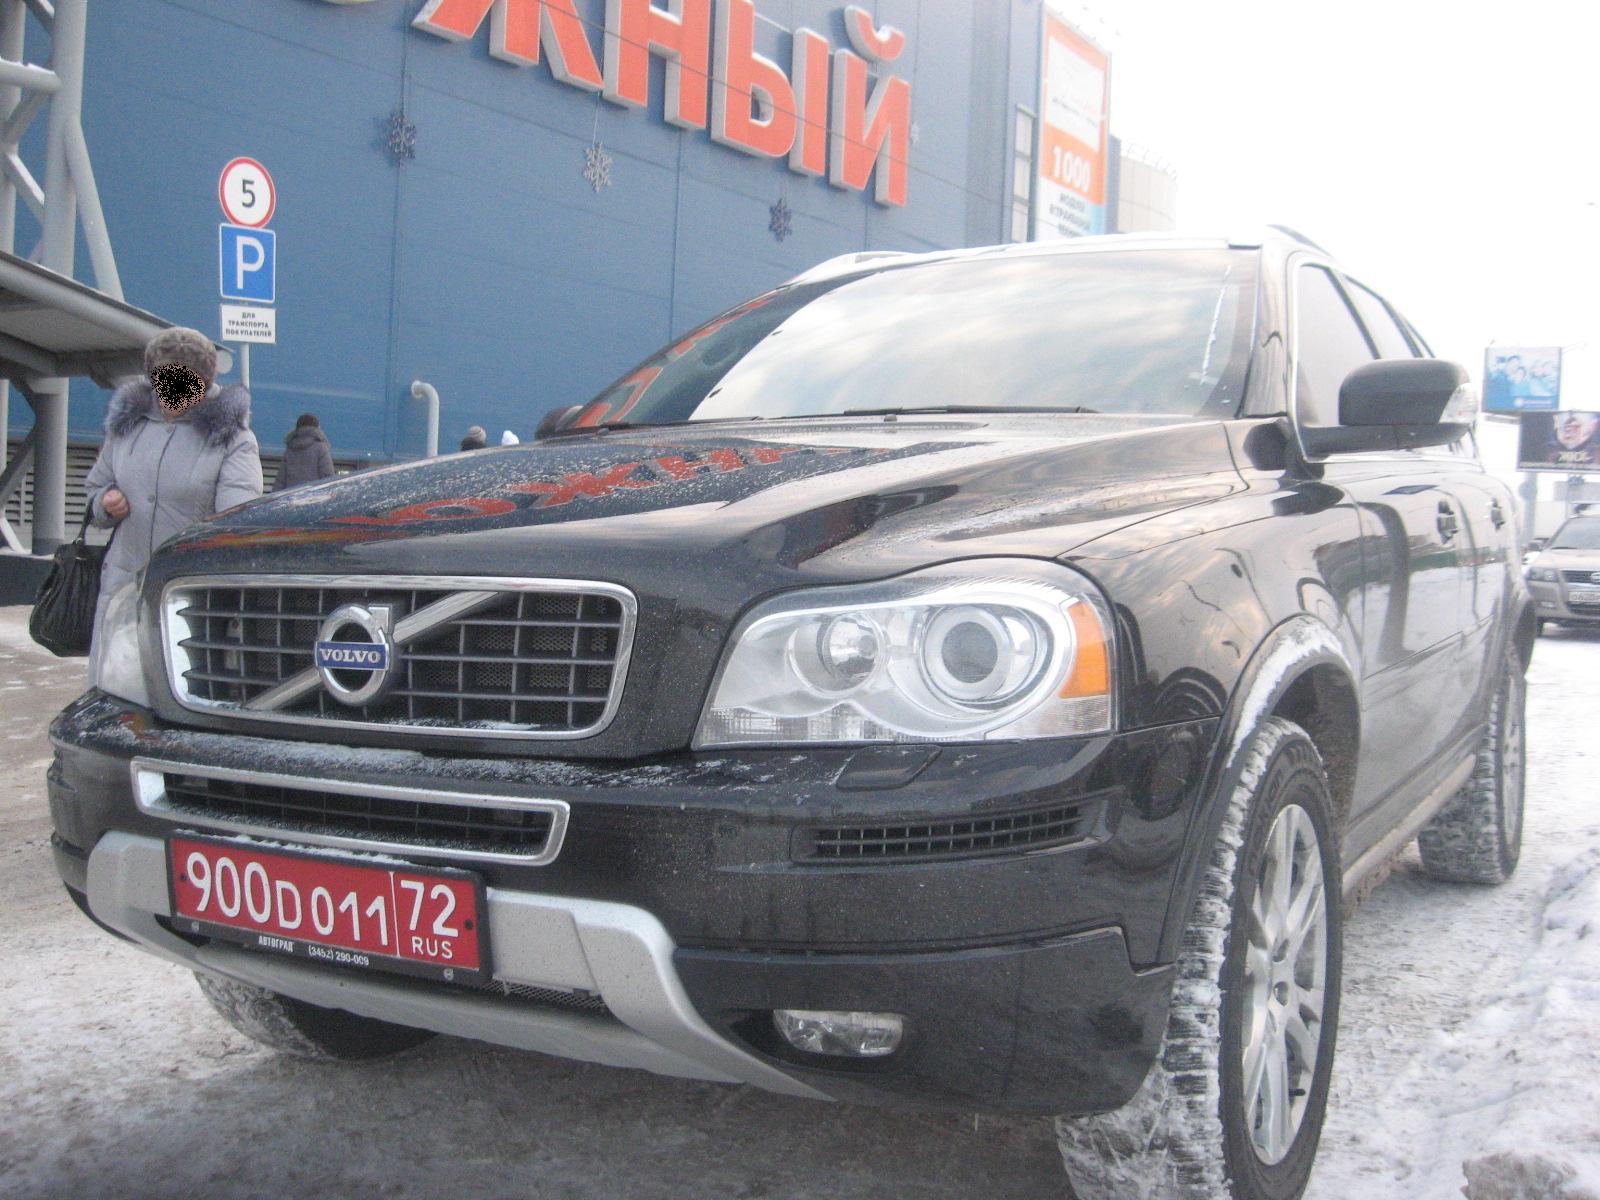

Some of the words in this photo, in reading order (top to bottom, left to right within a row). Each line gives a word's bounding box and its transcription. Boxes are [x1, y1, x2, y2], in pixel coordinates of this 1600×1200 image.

[1053, 146, 1091, 192] 1000
[242, 179, 256, 208] 5
[236, 235, 265, 289] P
[225, 329, 272, 337] ПОКУПАТЕЛЕЙ
[228, 320, 270, 329] ТРАНСПОРТА
[319, 648, 382, 663] VOLVO
[400, 879, 459, 938] 72
[258, 935, 295, 953] АВТОГРАД
[308, 945, 335, 960] (3452)
[411, 936, 454, 959] RUS
